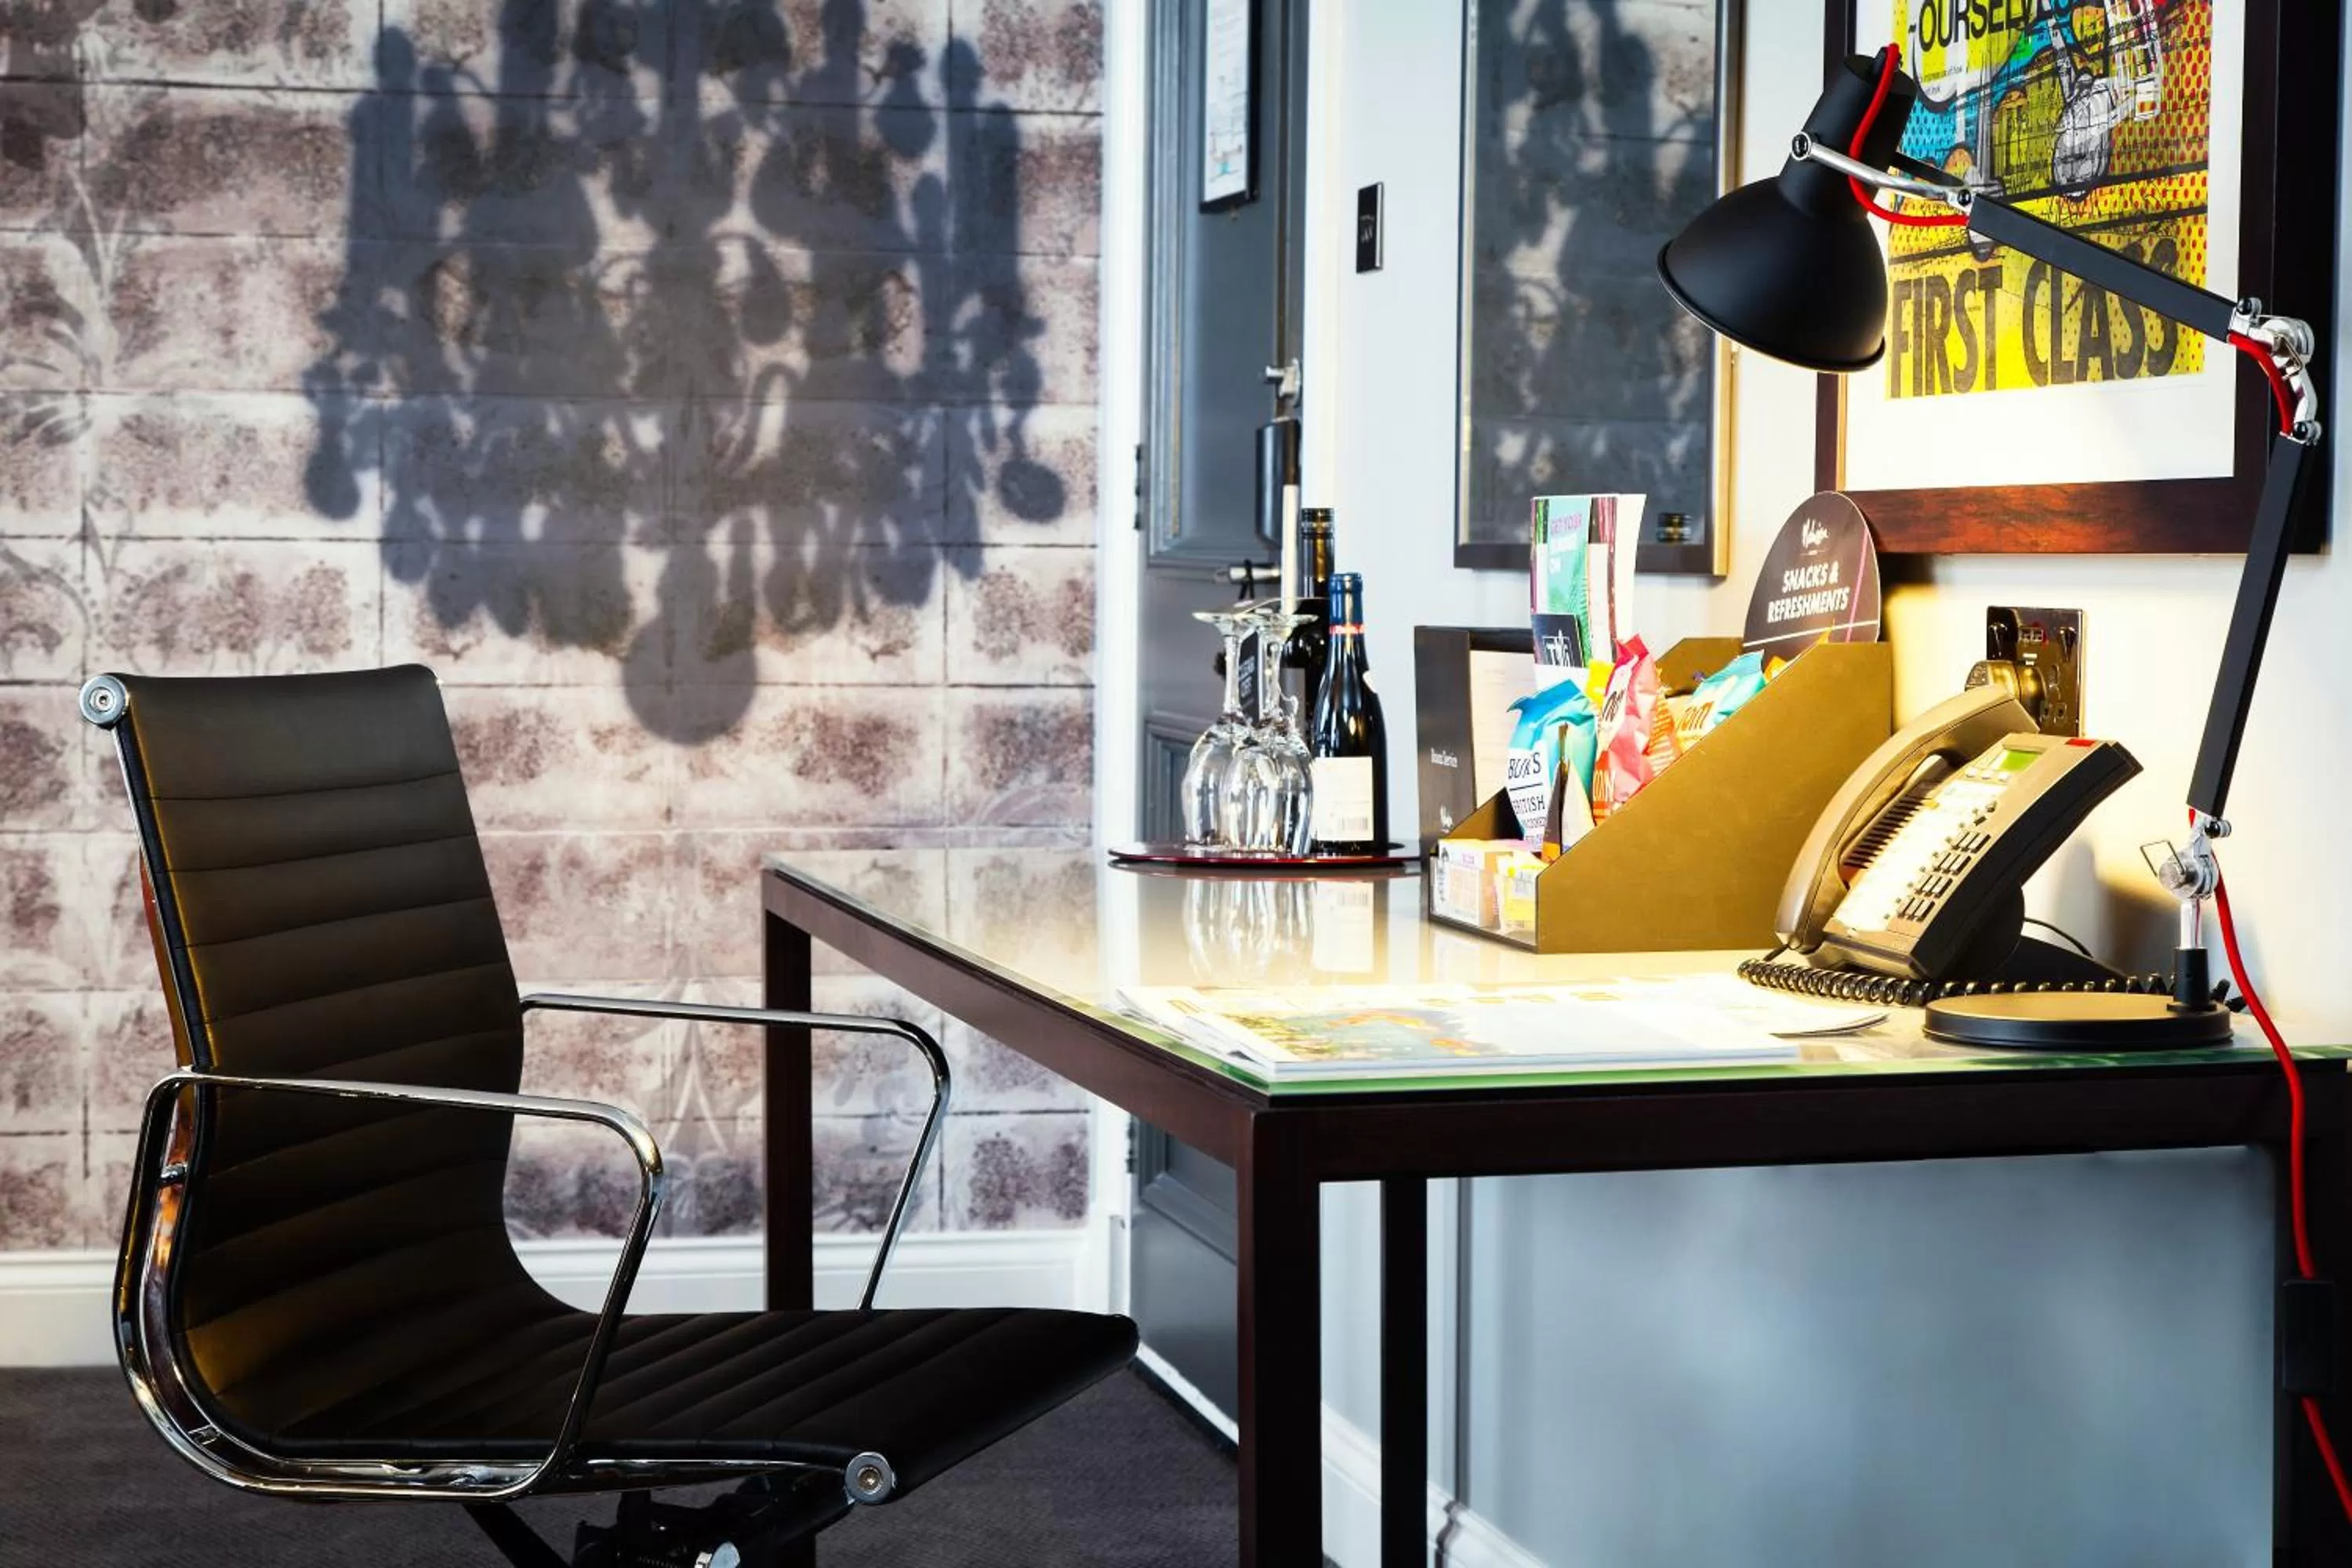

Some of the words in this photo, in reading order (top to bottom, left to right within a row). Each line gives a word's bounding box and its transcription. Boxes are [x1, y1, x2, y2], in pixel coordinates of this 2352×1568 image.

[1890, 263, 2003, 398] FIRST
[2022, 238, 2178, 387] CLASS
[1782, 563, 1829, 593] SNACKS
[1767, 586, 1850, 624] REFRESHMENTS
